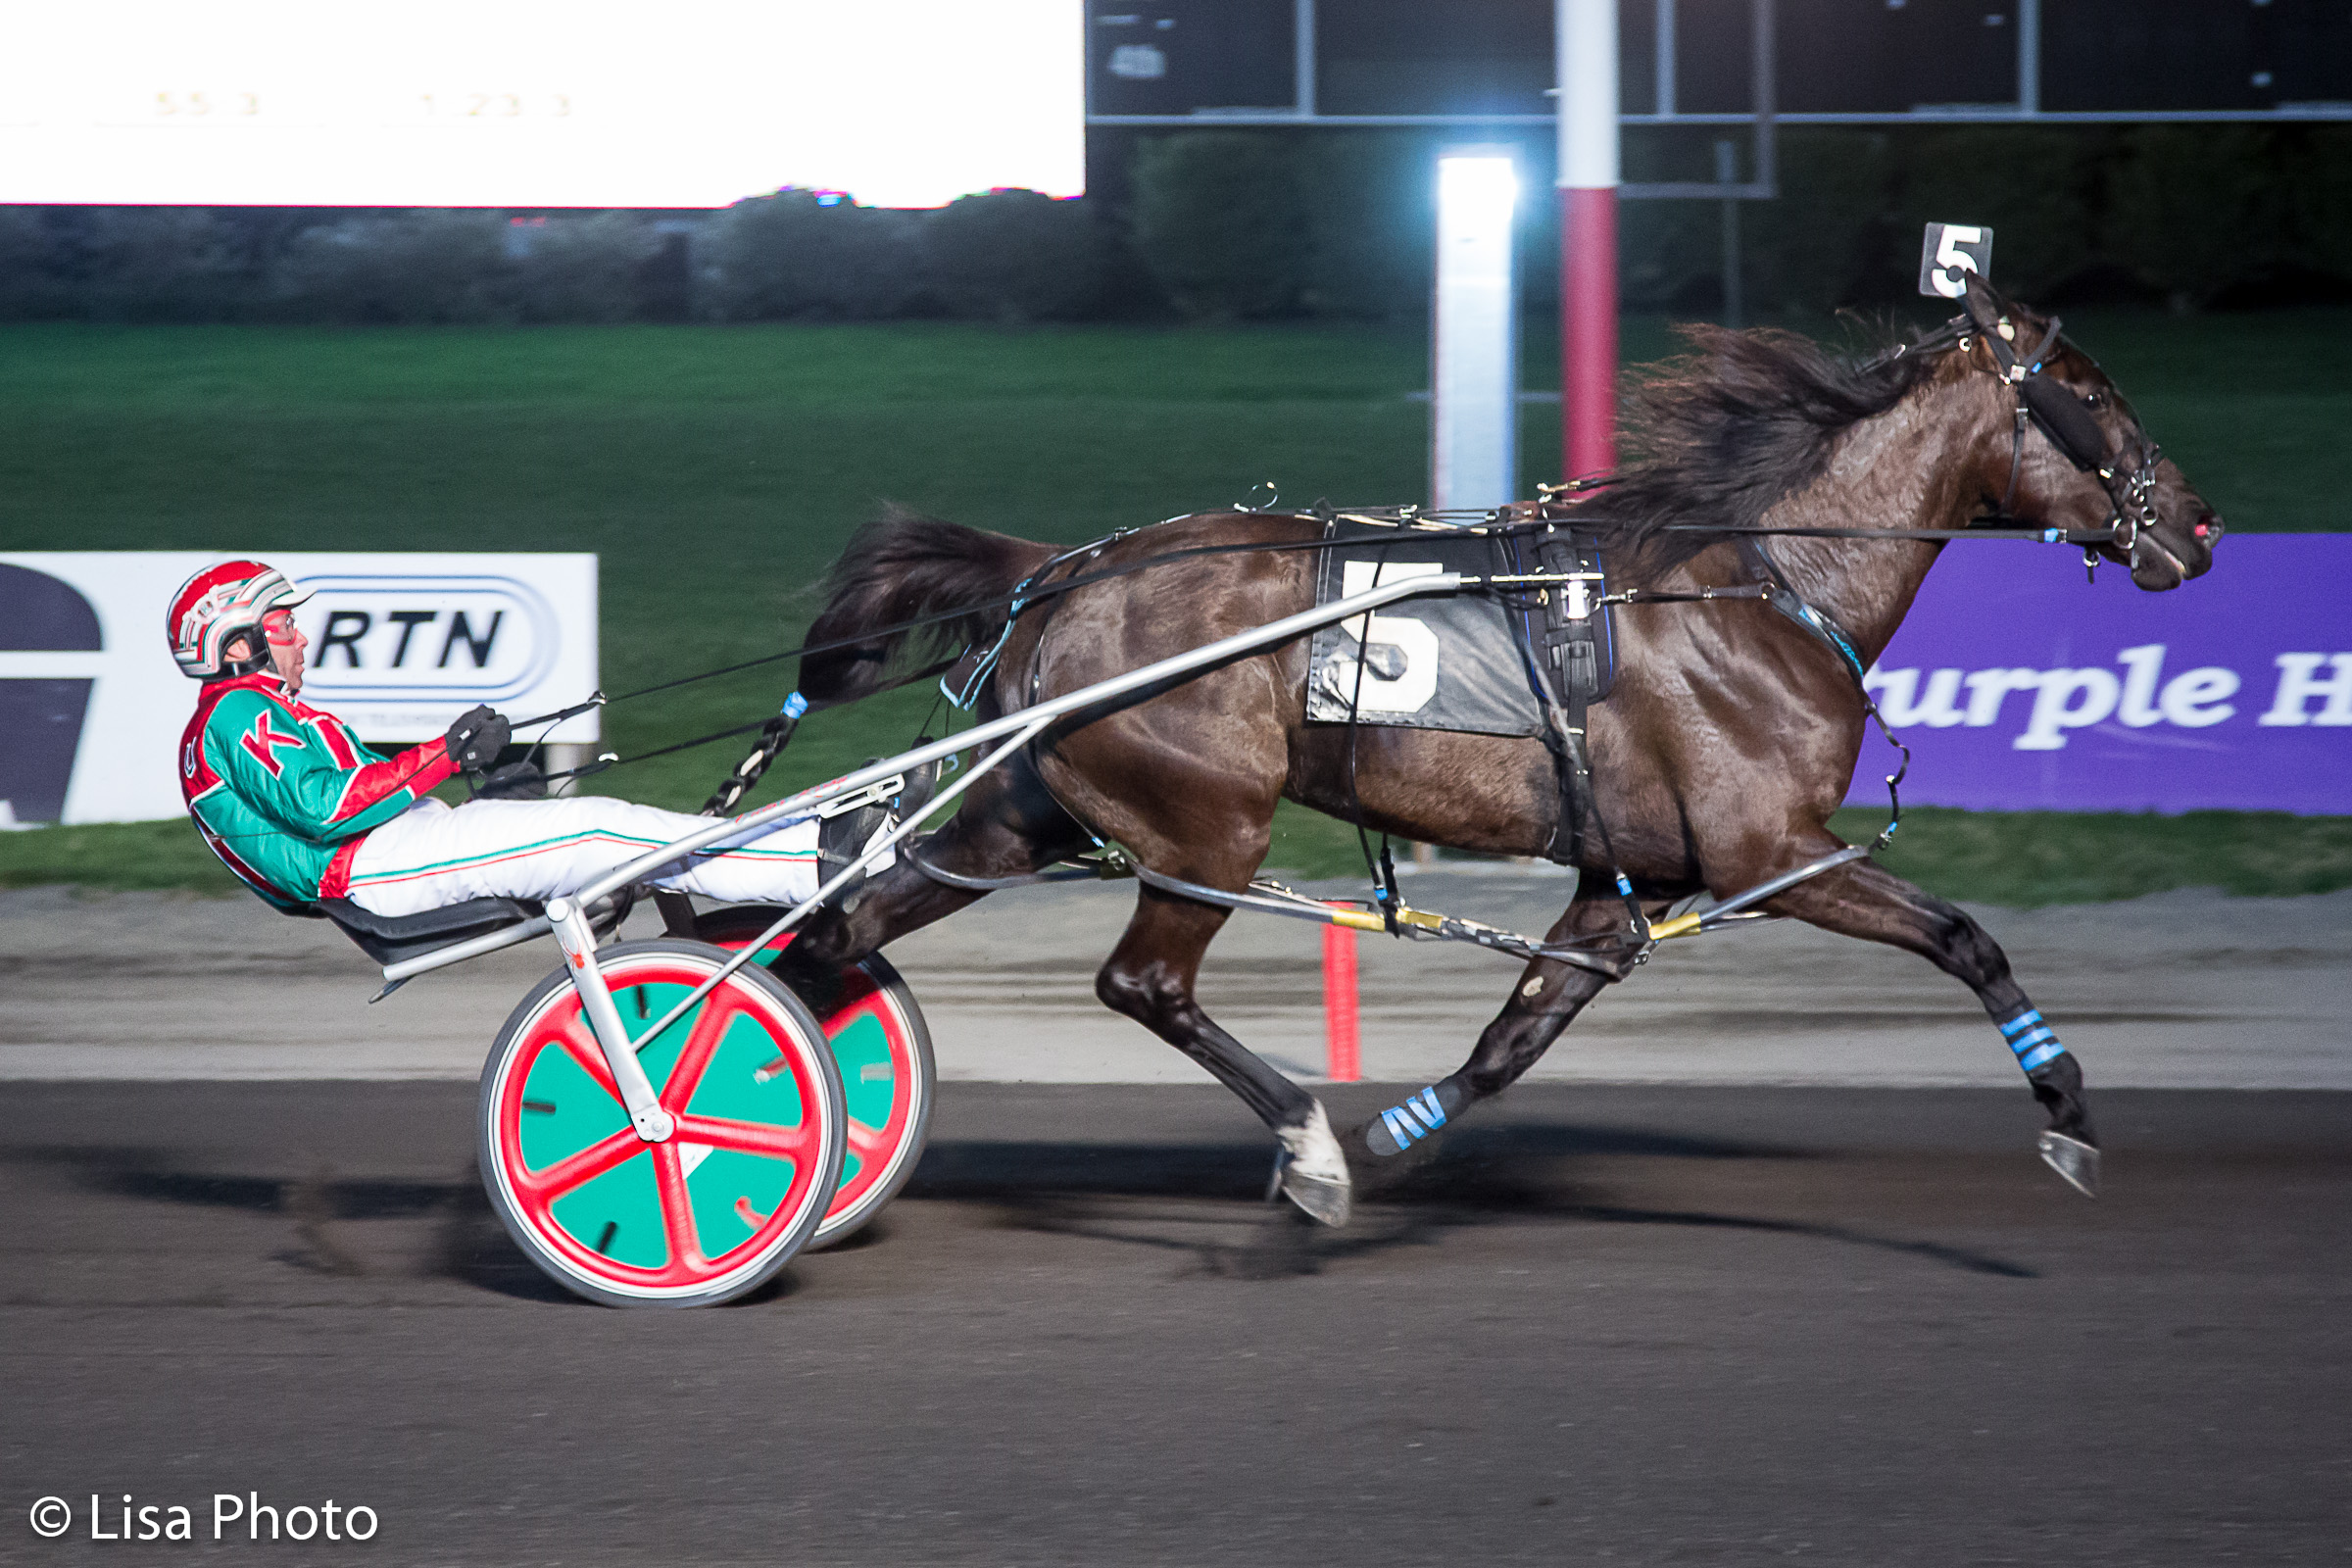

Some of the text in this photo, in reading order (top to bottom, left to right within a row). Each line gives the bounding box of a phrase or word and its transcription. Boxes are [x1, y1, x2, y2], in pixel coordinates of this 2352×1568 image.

[1931, 224, 1982, 299] 5
[313, 611, 503, 668] RTN
[1338, 560, 1445, 713] 5
[1863, 644, 2241, 751] urple
[239, 708, 307, 781] K
